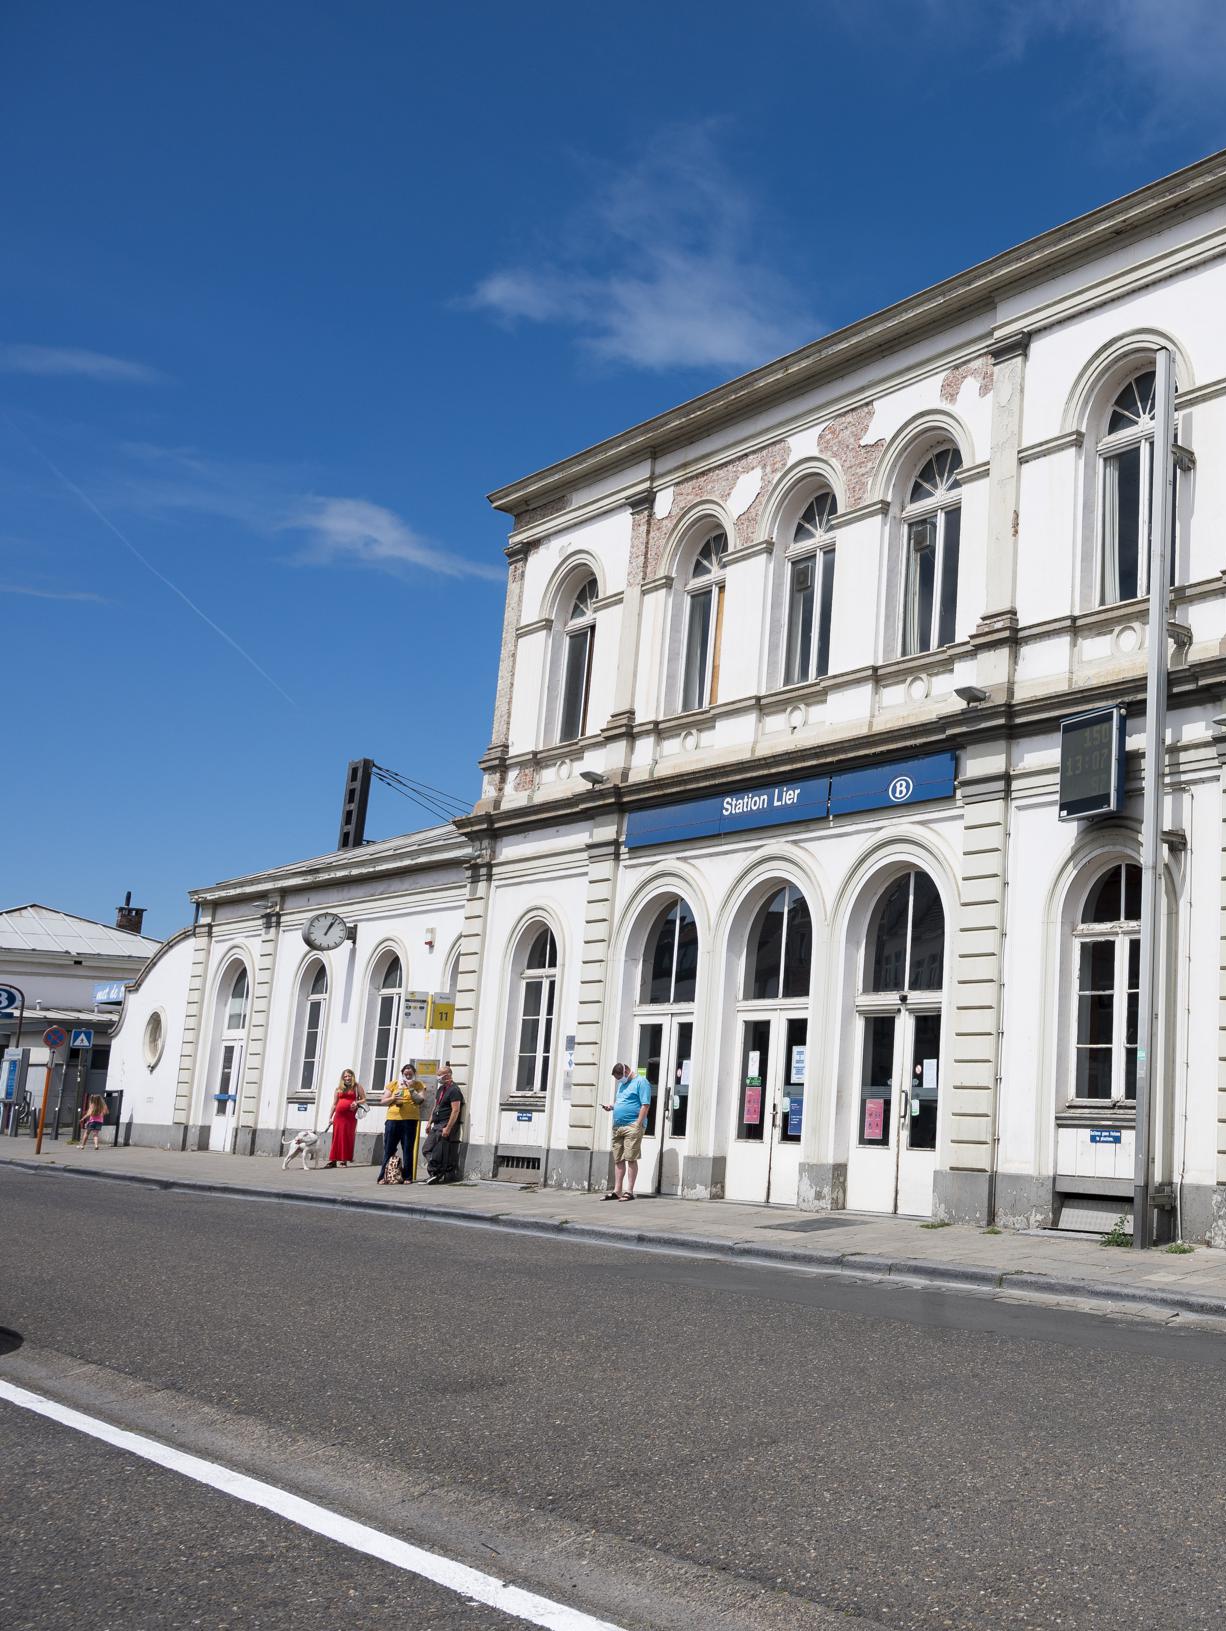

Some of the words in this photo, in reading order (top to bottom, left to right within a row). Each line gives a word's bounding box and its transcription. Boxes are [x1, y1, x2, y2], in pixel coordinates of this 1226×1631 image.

[1066, 748, 1109, 777] 13:07
[722, 794, 768, 816] Station
[774, 787, 800, 807] Lier
[439, 1011, 449, 1022] 11
